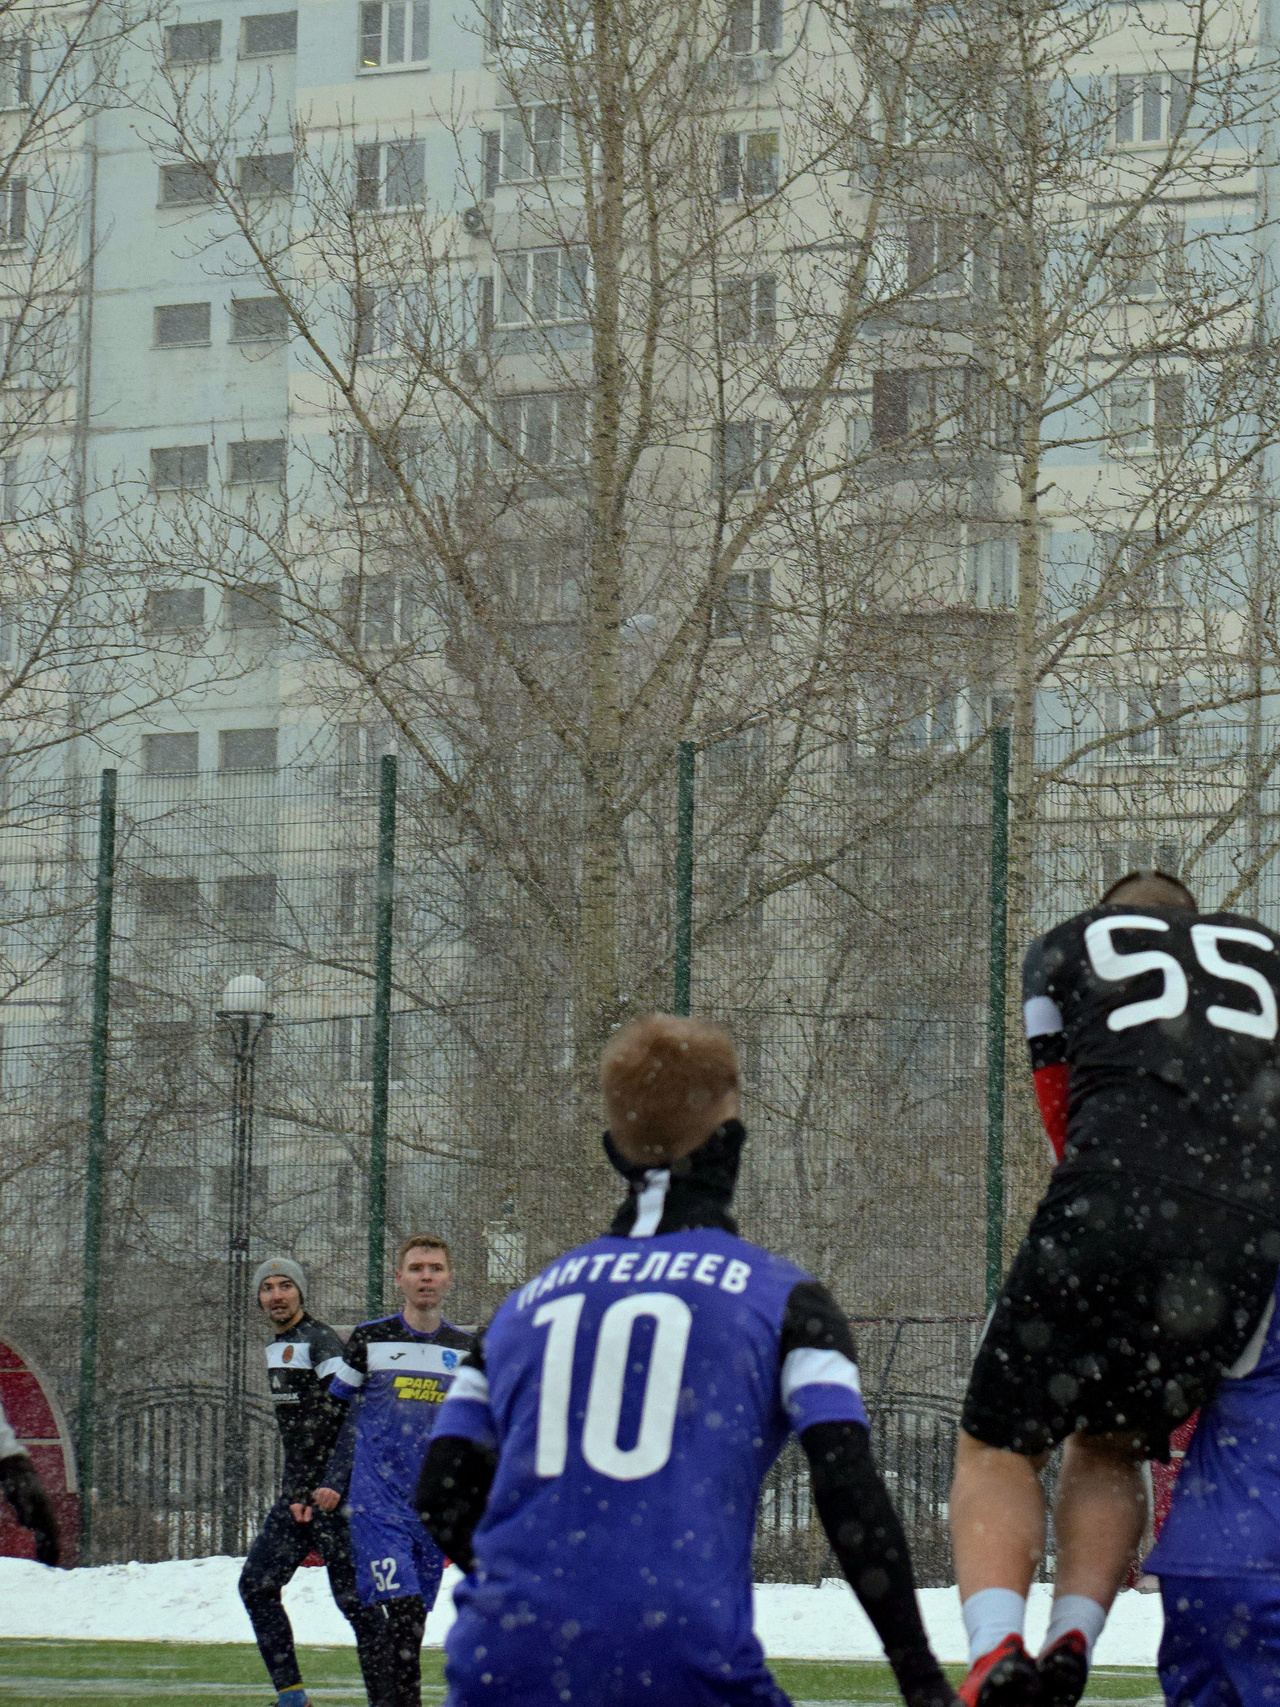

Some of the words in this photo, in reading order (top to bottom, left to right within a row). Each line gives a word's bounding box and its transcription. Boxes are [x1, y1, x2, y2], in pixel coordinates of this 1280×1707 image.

[1084, 914, 1279, 1040] 55
[516, 1251, 751, 1311] ПАНТЕЛЕЕВ
[396, 1376, 439, 1391] PARI
[532, 1292, 692, 1480] 10
[370, 1557, 401, 1592] 52
